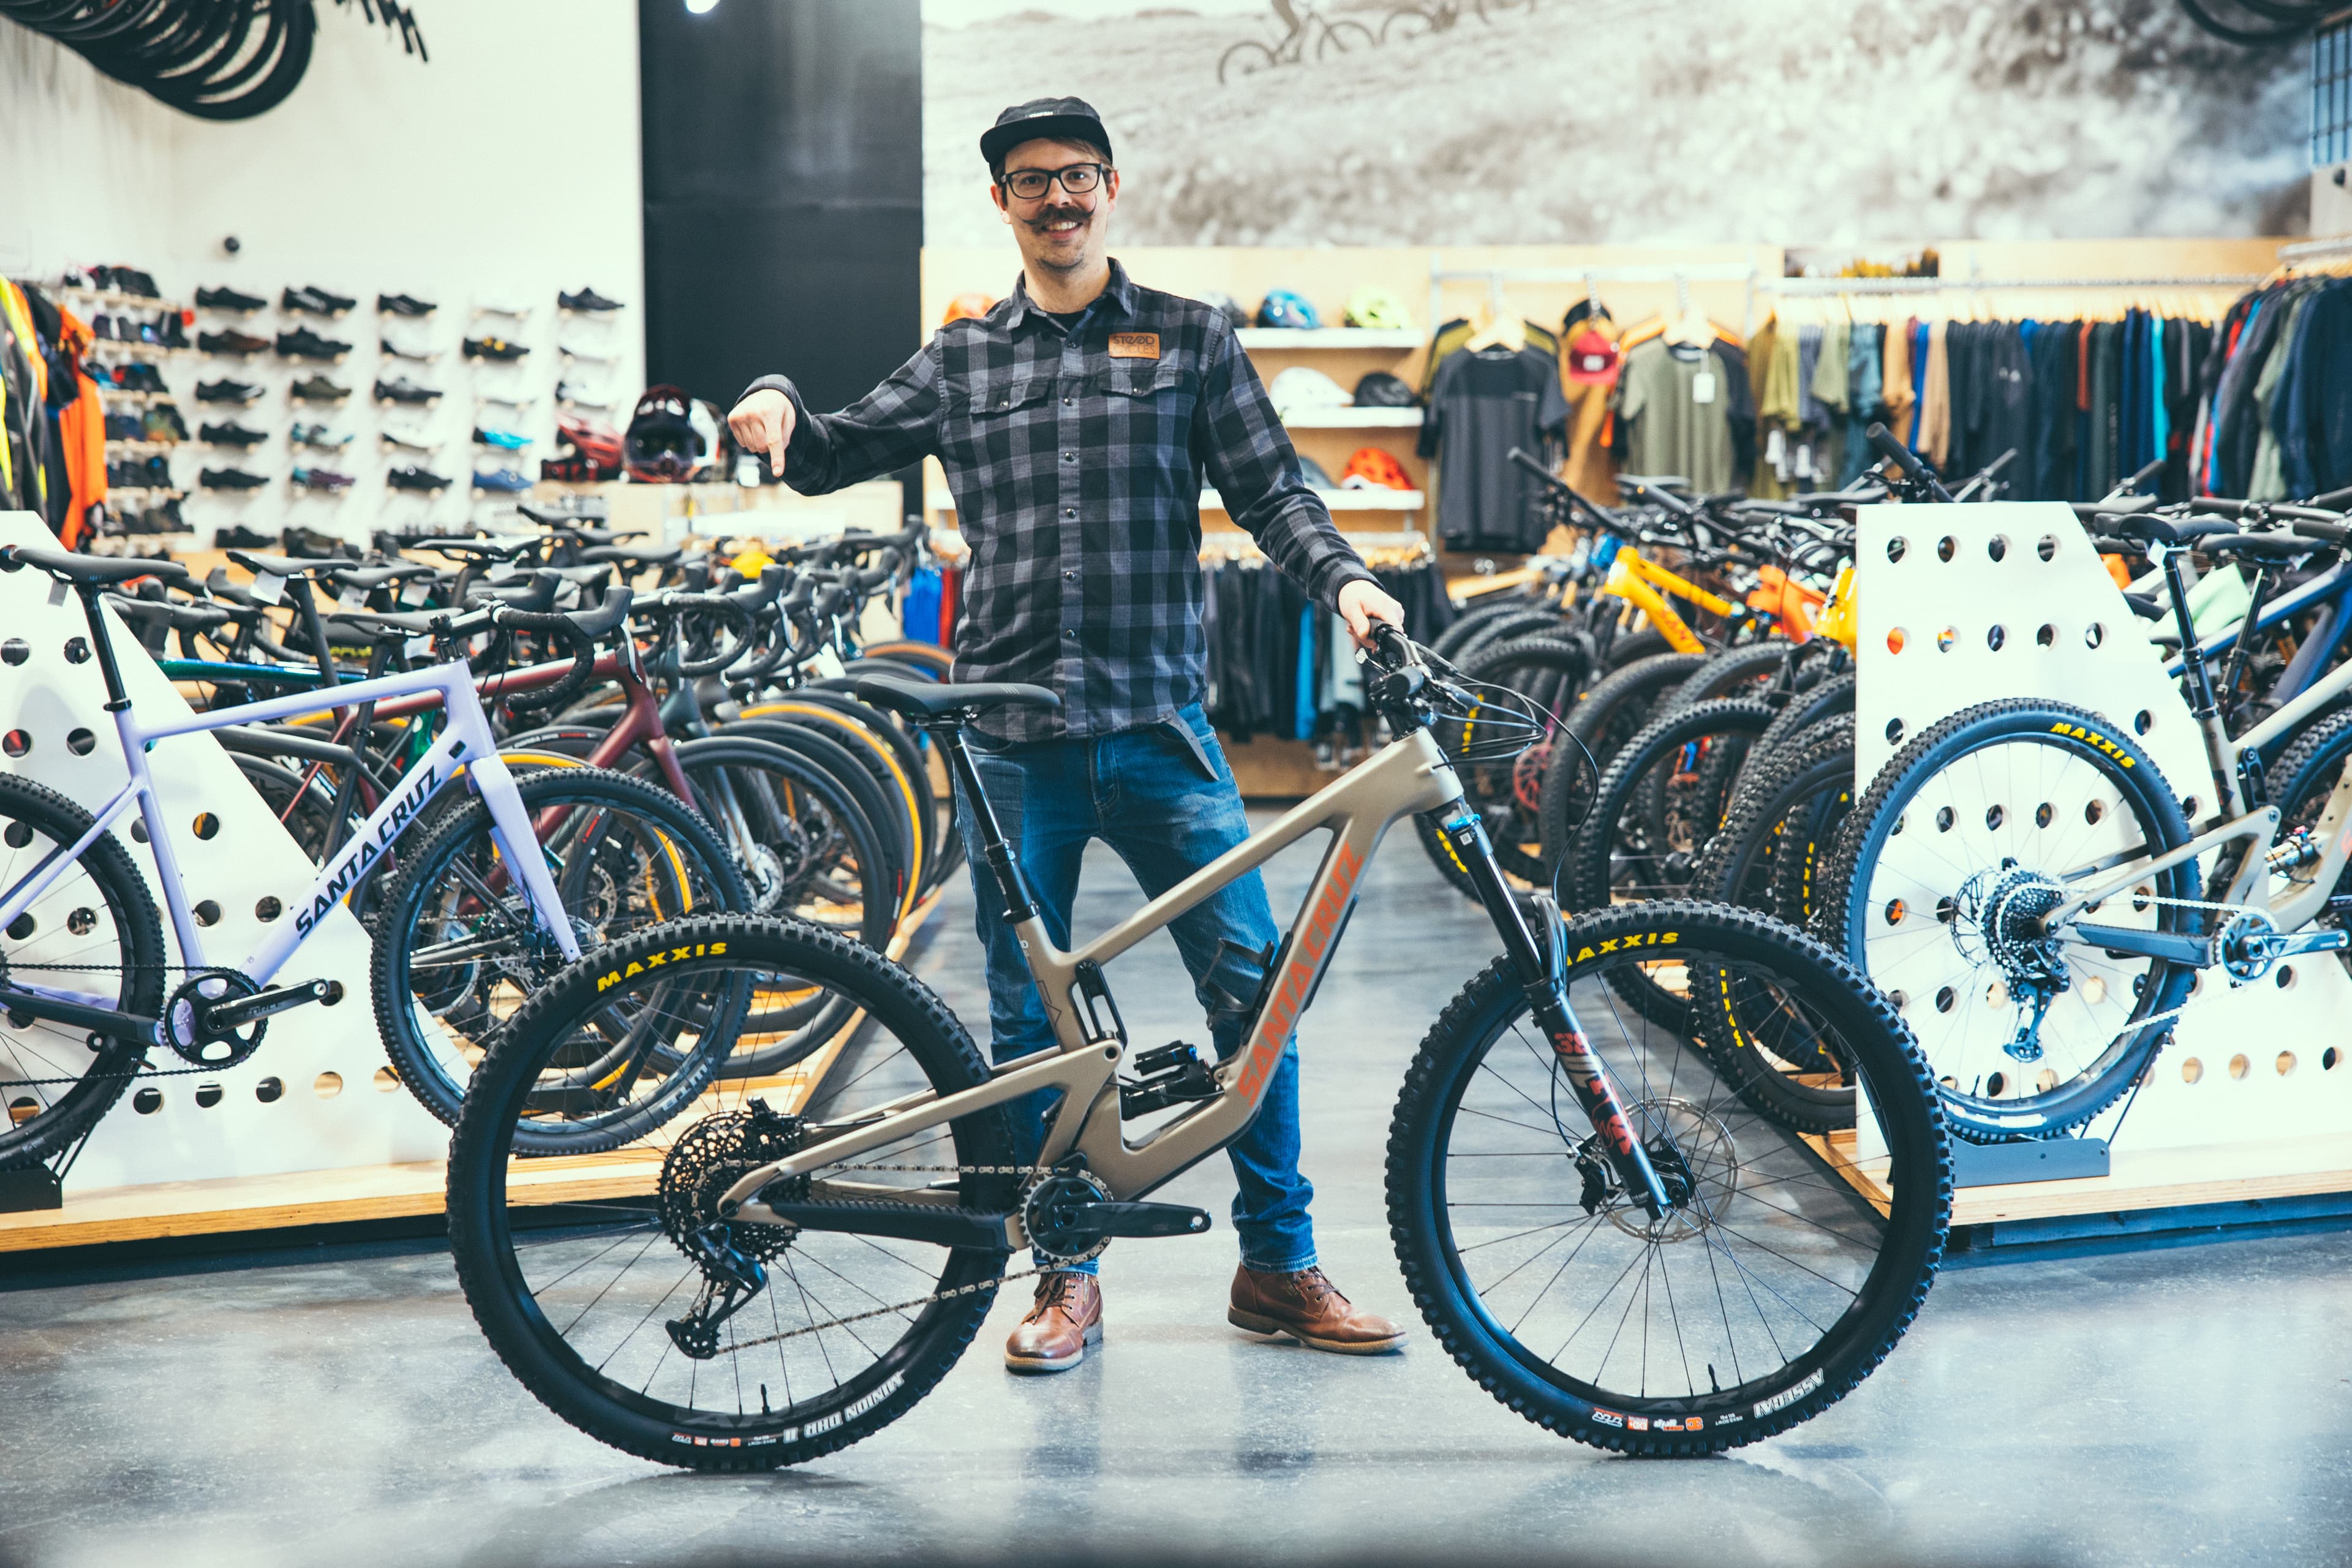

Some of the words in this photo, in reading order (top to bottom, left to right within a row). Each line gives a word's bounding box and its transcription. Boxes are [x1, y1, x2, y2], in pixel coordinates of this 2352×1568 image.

[1113, 345, 1156, 355] CYCLES
[2049, 722, 2135, 769] MAXXIS
[295, 841, 379, 940] SANTA
[377, 764, 442, 845] CRUZ
[1803, 842, 1815, 922] AXXIS
[597, 941, 728, 992] MAXXIS
[1237, 961, 1314, 1107] SANTA
[1303, 841, 1363, 961] CRUZ
[1567, 935, 1679, 967] AXXIS
[1720, 968, 1744, 1048] MAXXI
[844, 1370, 905, 1422] MINION
[804, 1411, 843, 1438] DHR
